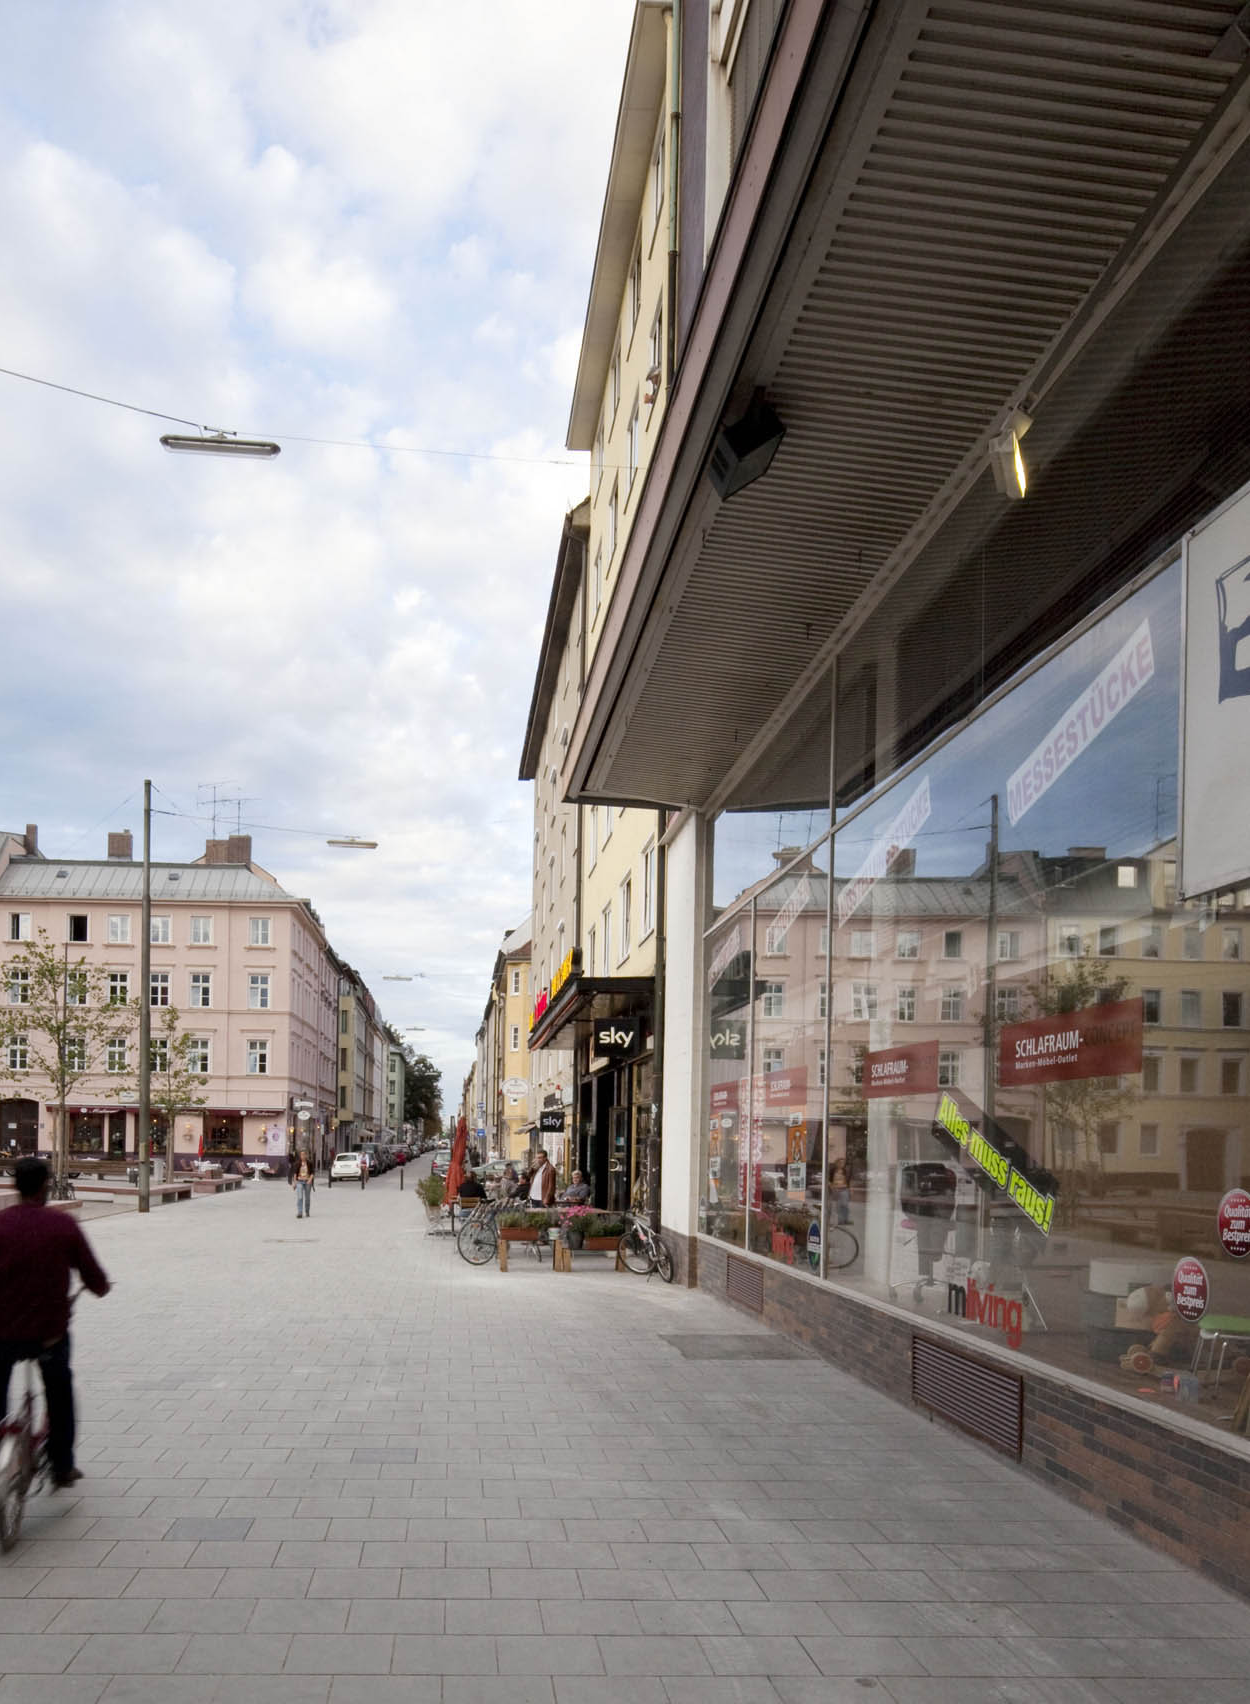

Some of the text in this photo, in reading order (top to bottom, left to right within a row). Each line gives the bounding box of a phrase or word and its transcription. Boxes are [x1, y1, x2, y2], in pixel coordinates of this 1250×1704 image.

[1008, 633, 1154, 822] MESSESTÜCKE
[599, 1026, 634, 1048] sky
[1015, 1029, 1084, 1058] SCHLAFRAUM-
[542, 1116, 562, 1128] sky
[936, 1093, 1053, 1234] Alles muss raus!
[1230, 1219, 1246, 1230] zum
[1177, 1270, 1204, 1286] Qualität
[1177, 1292, 1205, 1309] Bestpreis
[1183, 1285, 1198, 1297] zum
[948, 1277, 1022, 1351] mliving
